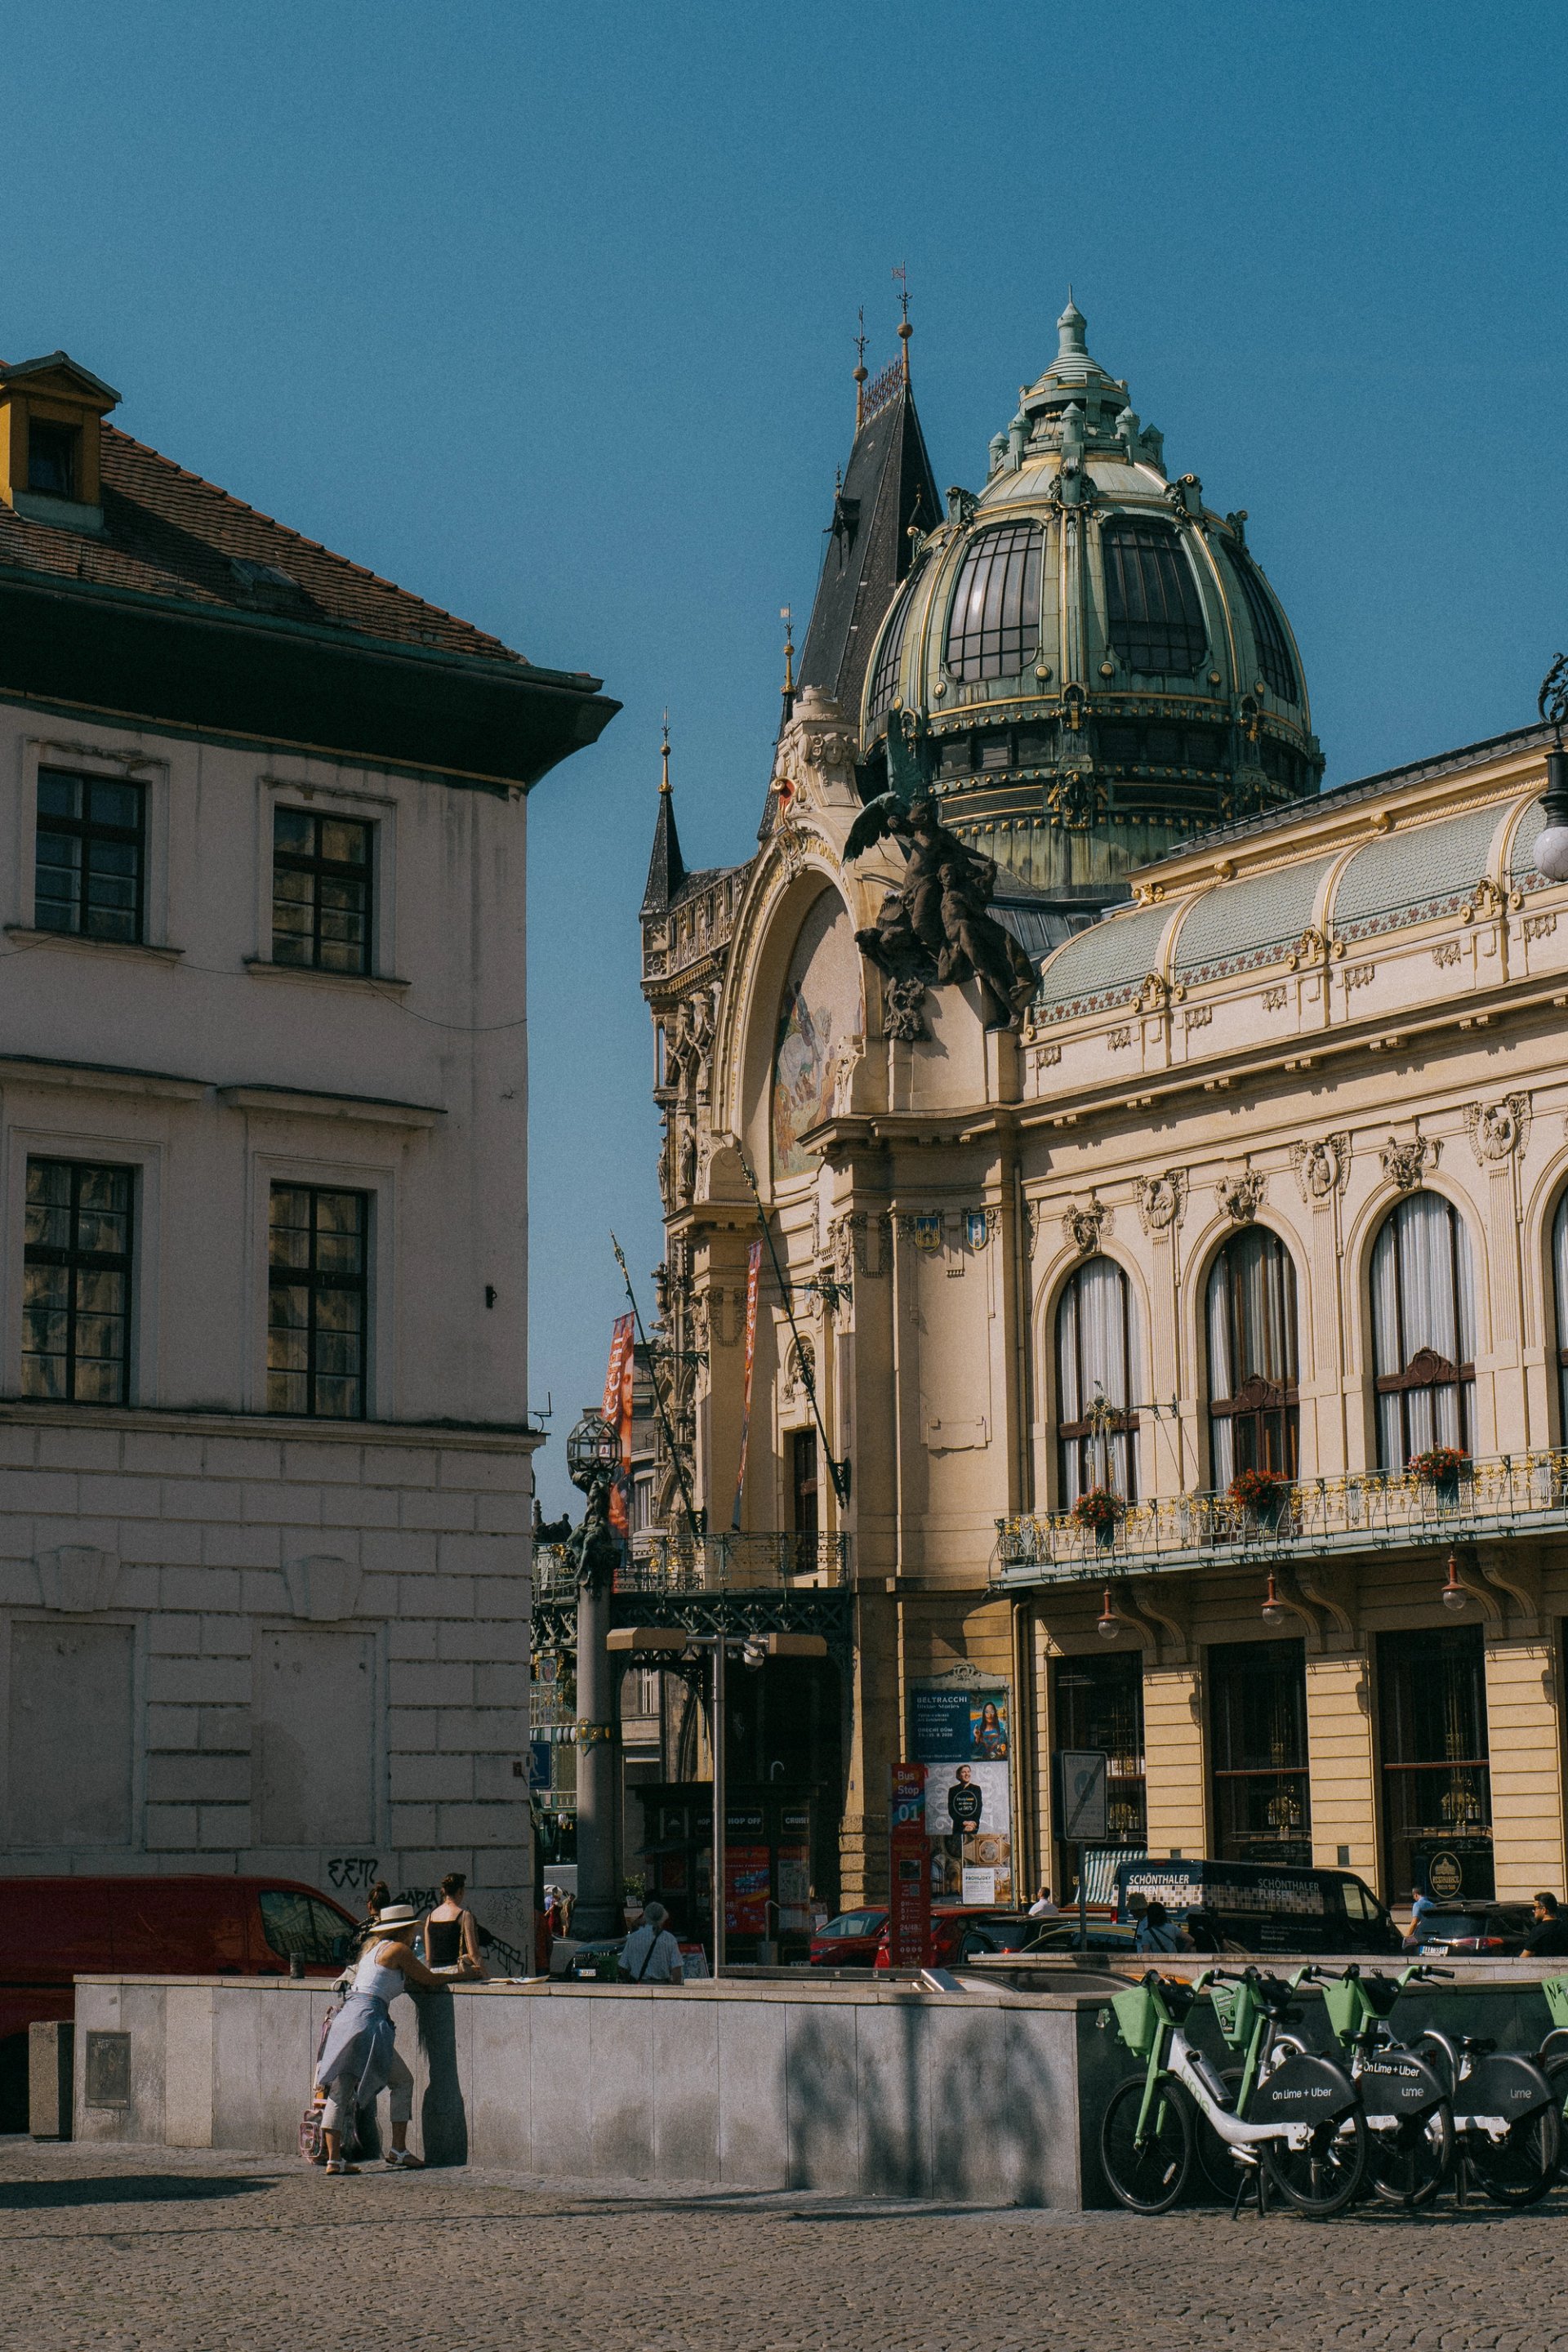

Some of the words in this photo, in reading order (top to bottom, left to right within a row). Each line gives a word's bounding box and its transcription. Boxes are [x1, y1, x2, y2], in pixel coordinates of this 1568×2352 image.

[898, 1771, 915, 1780] Bus
[898, 1784, 920, 1796] Stop
[898, 1804, 920, 1822] 01
[1129, 1873, 1190, 1885] SCHÖNTHALER
[1258, 1878, 1320, 1891] SCHÖNTHALER
[1258, 1889, 1293, 1900] FLIESEN
[1363, 2061, 1374, 2073] On
[1374, 2064, 1392, 2074] Lime
[1399, 2065, 1420, 2077] Uber
[1272, 2091, 1282, 2100] On
[1284, 2088, 1302, 2099] Lime
[1311, 2087, 1332, 2097] Uber
[1401, 2087, 1423, 2097] Lime
[1511, 2088, 1532, 2099] Lime
